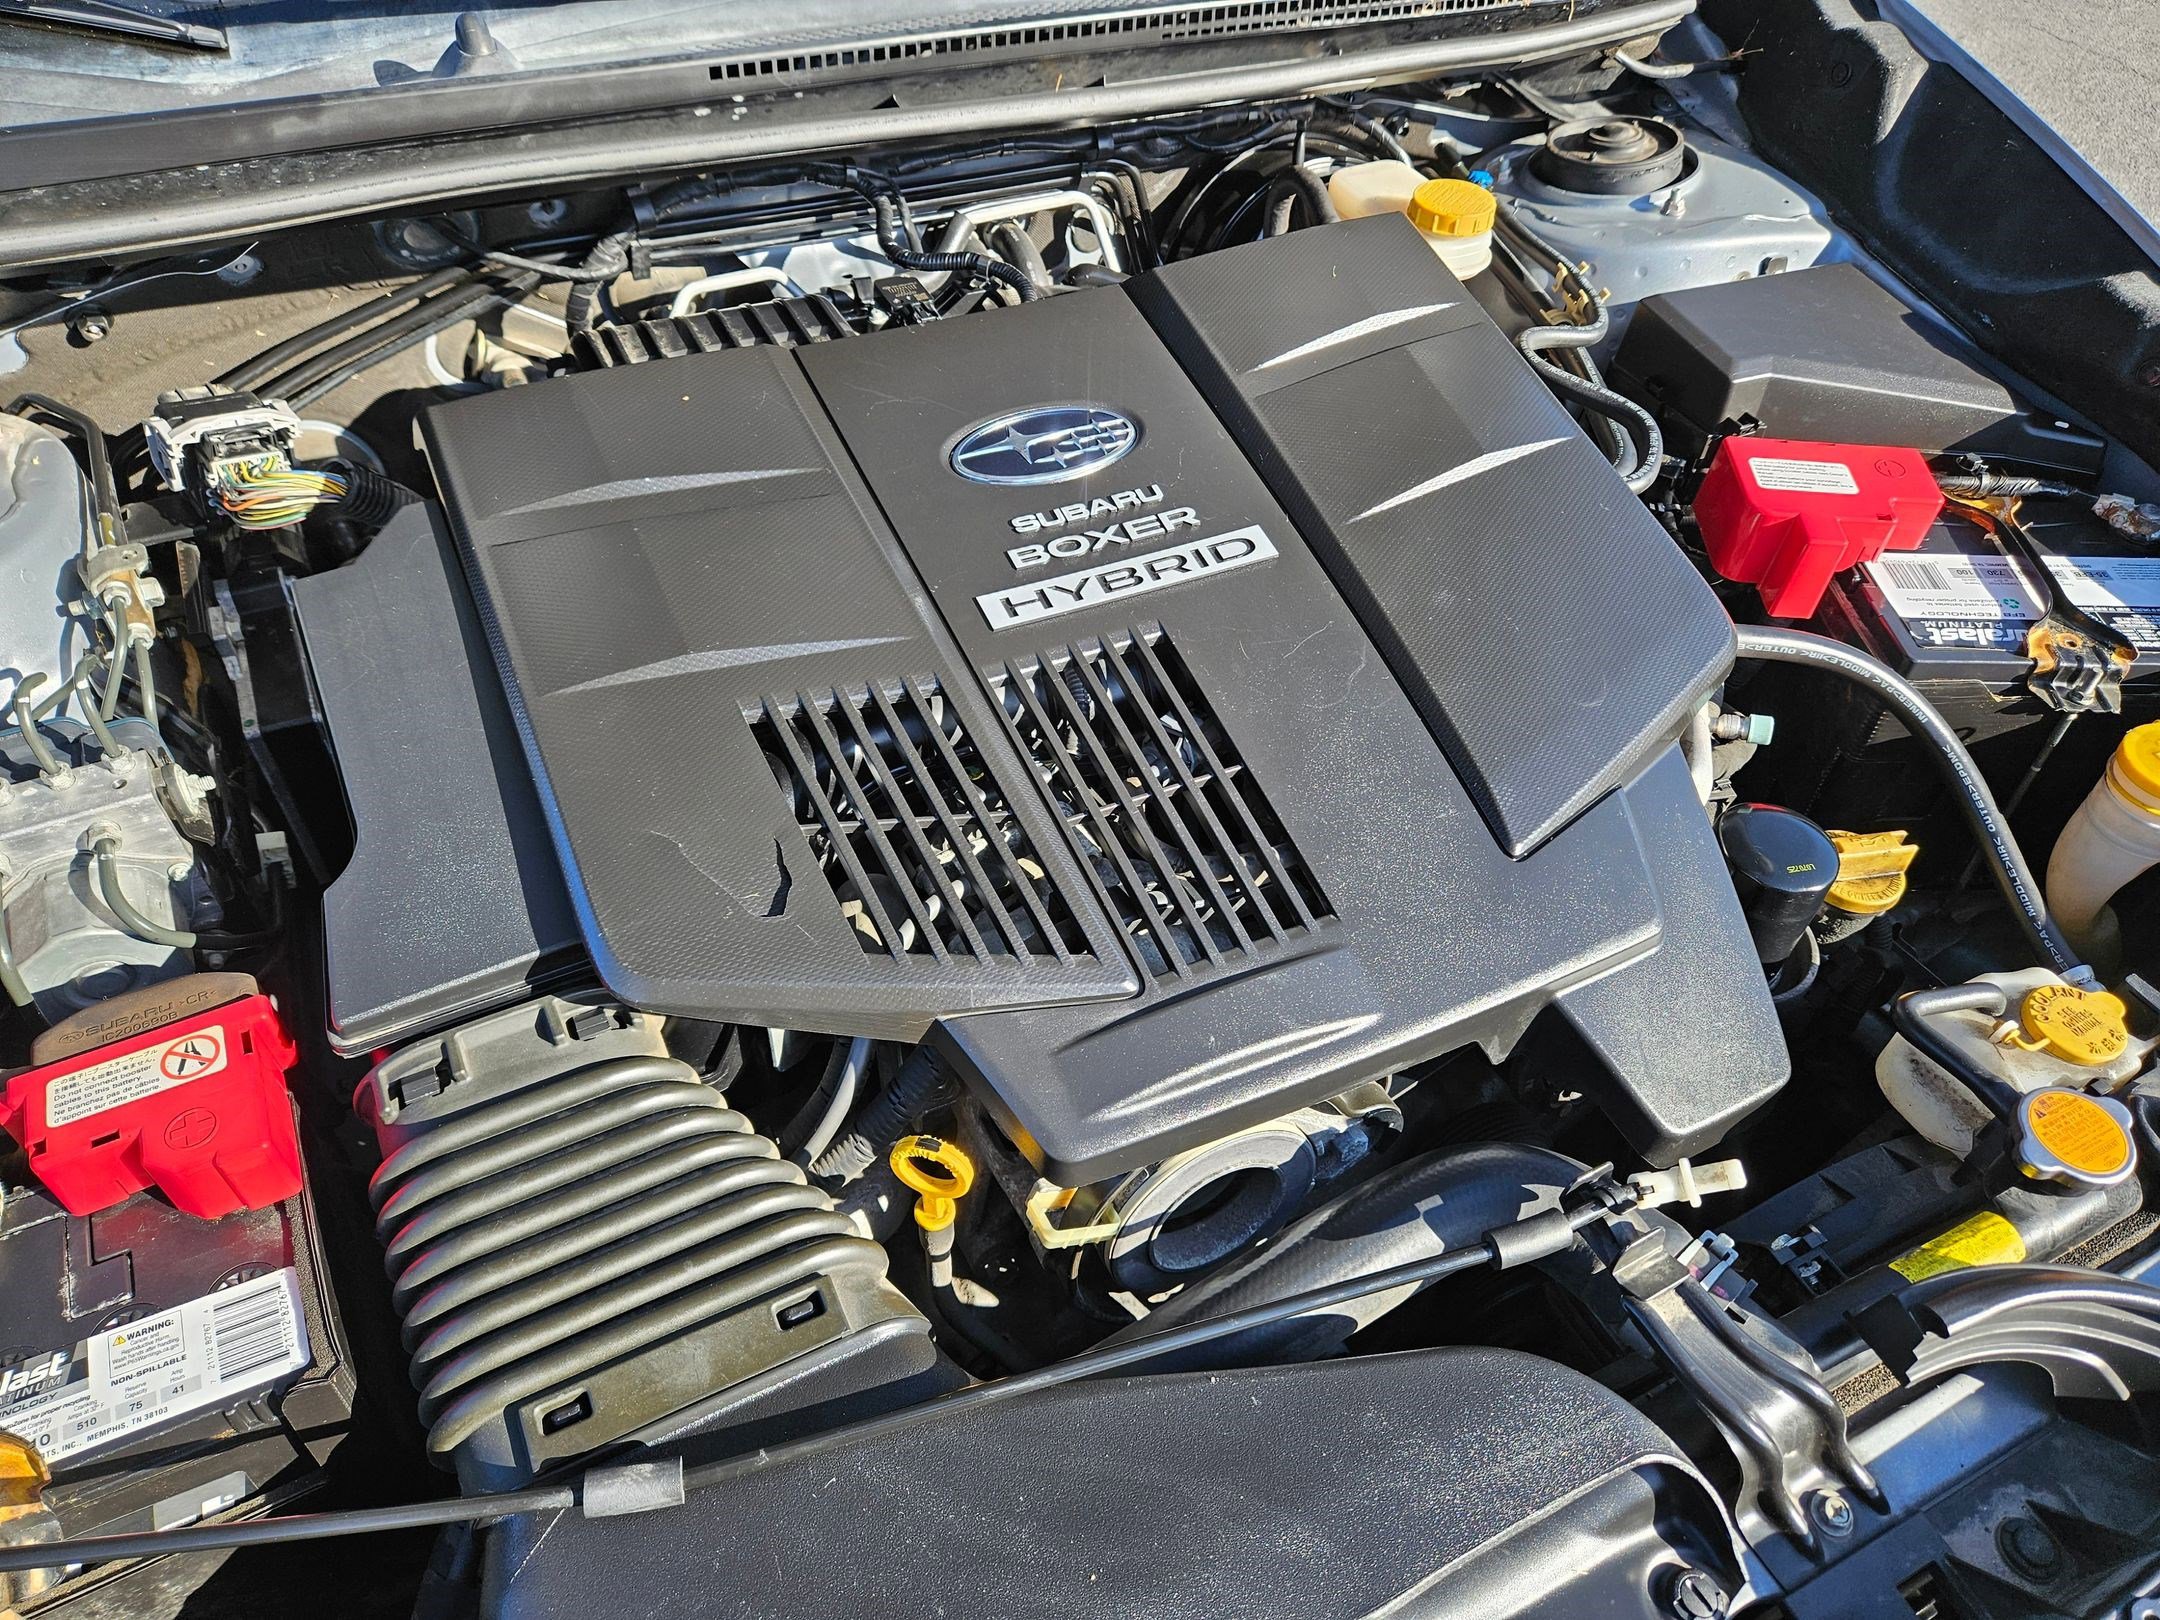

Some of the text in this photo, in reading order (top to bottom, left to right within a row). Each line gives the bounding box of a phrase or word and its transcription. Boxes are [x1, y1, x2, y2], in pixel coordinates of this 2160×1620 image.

[1008, 484, 1164, 533] SUBARU
[1004, 507, 1201, 570] BOXER
[1000, 537, 1256, 618] HYBRID
[1737, 643, 1797, 654] OUTER>E
[2033, 921, 2069, 971] ER>PA<
[2035, 986, 2087, 1024] COOLANT
[85, 1001, 174, 1037] SUBARU
[53, 1065, 153, 1102] Do not connect booster
[53, 1075, 144, 1109] cables to this battery.
[54, 1076, 161, 1117] Ne branchez pas de câbles
[53, 1084, 162, 1125] d'appoint sur cette batterie.
[892, 1148, 937, 1162] ENGINE
[126, 1319, 175, 1341] WARNING:
[130, 1332, 160, 1346] Cancer and
[112, 1356, 127, 1365] Wash
[128, 1349, 145, 1359] hands
[145, 1344, 157, 1354] after
[121, 1339, 155, 1356] Reproductive
[0, 1350, 70, 1397] last
[111, 1354, 188, 1387] NON-SPILLABLE
[170, 1374, 186, 1383] Hours
[171, 1368, 184, 1377] Amp
[0, 1375, 62, 1406] TINUM
[124, 1388, 148, 1400] Capacity
[171, 1385, 185, 1395] 41
[0, 1391, 58, 1418] NOLOGY
[30, 1412, 40, 1421] for
[40, 1405, 62, 1419] proper
[62, 1395, 91, 1409] recycling
[73, 1400, 98, 1412] Cranking
[129, 1400, 143, 1412] 75
[77, 1417, 97, 1431] 510
[87, 1422, 129, 1442] MEMPHIS,
[132, 1416, 142, 1425] TN
[144, 1406, 168, 1420] 38103
